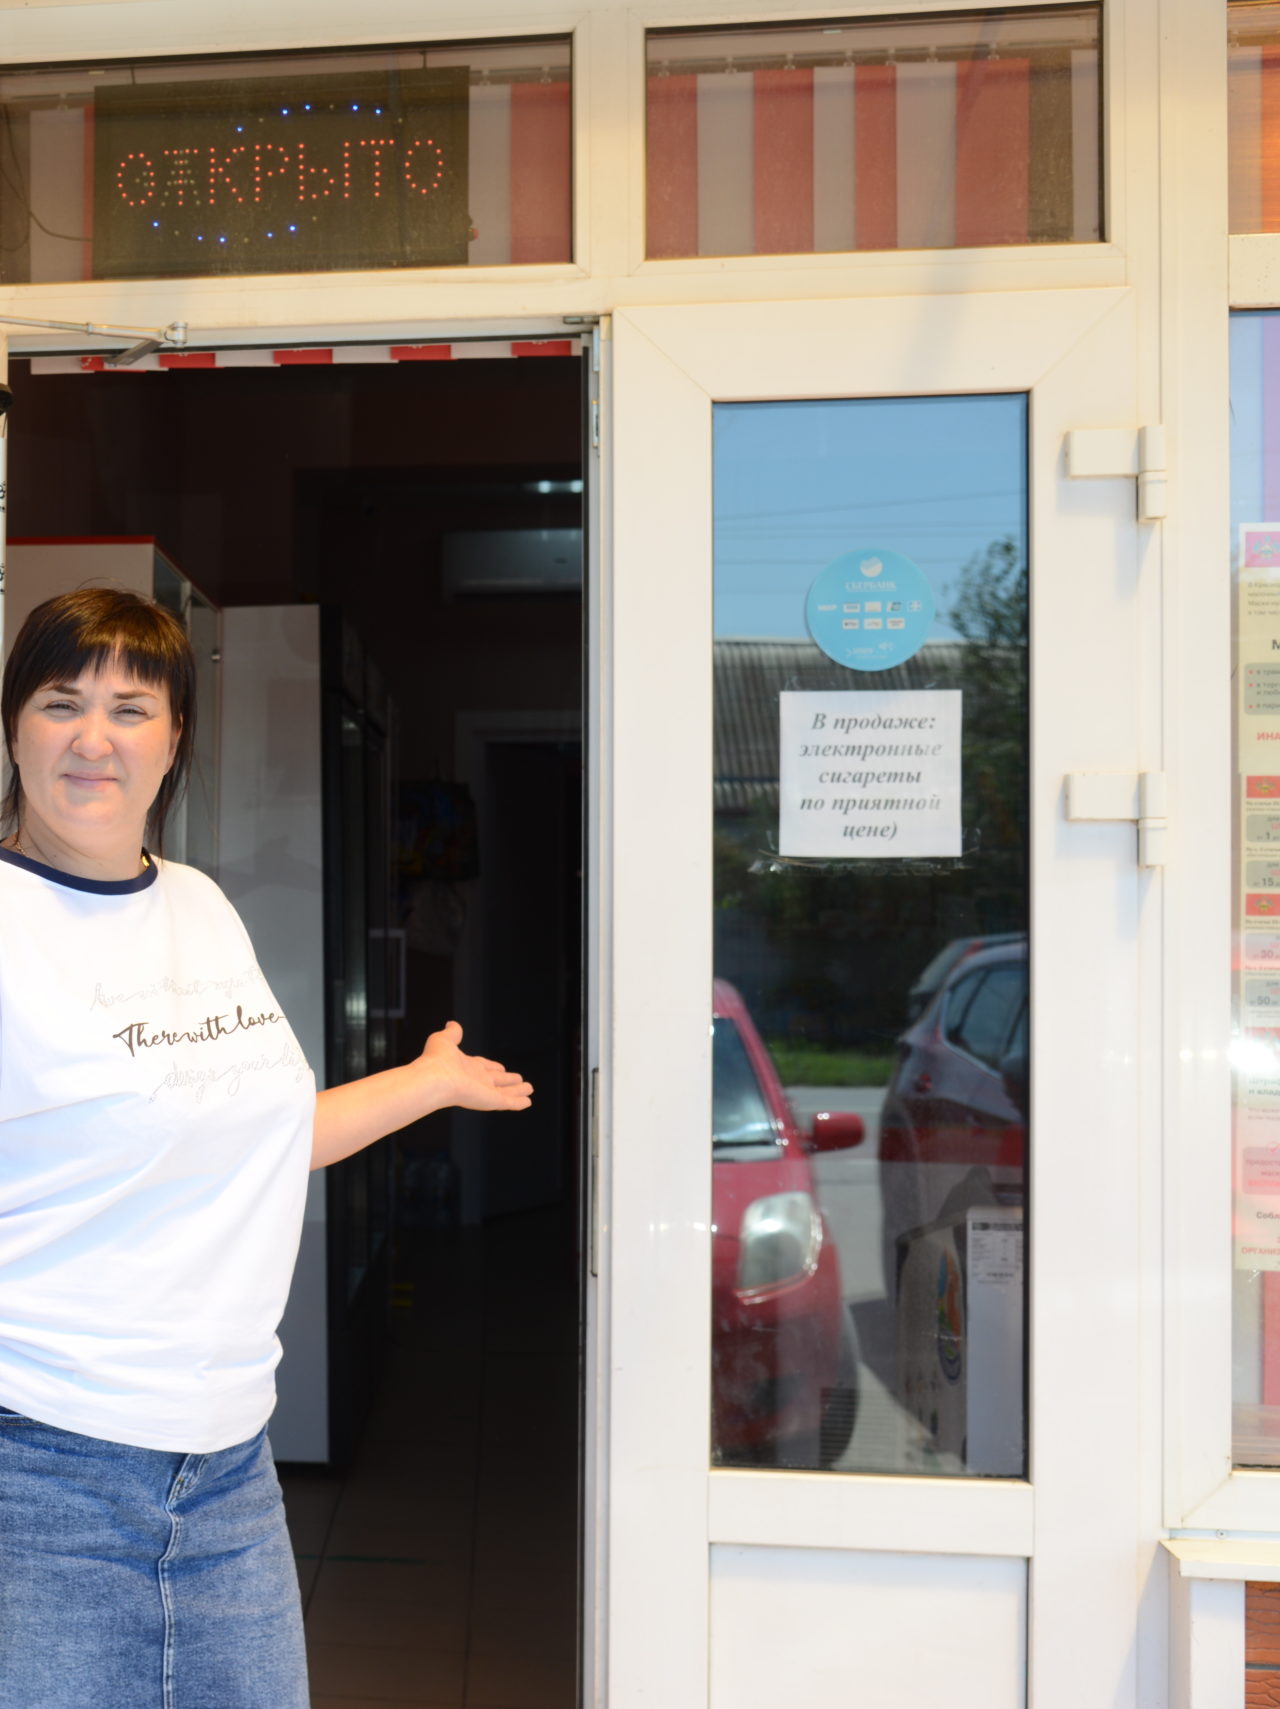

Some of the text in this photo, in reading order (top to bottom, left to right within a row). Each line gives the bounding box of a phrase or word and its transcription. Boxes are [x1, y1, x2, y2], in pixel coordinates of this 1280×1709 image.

[811, 713, 936, 735] В продаже:
[799, 743, 942, 761] электронные
[819, 770, 922, 788] сигареты
[800, 794, 941, 815] по приятной
[842, 823, 897, 841] цене)
[112, 1005, 287, 1057] There with love
